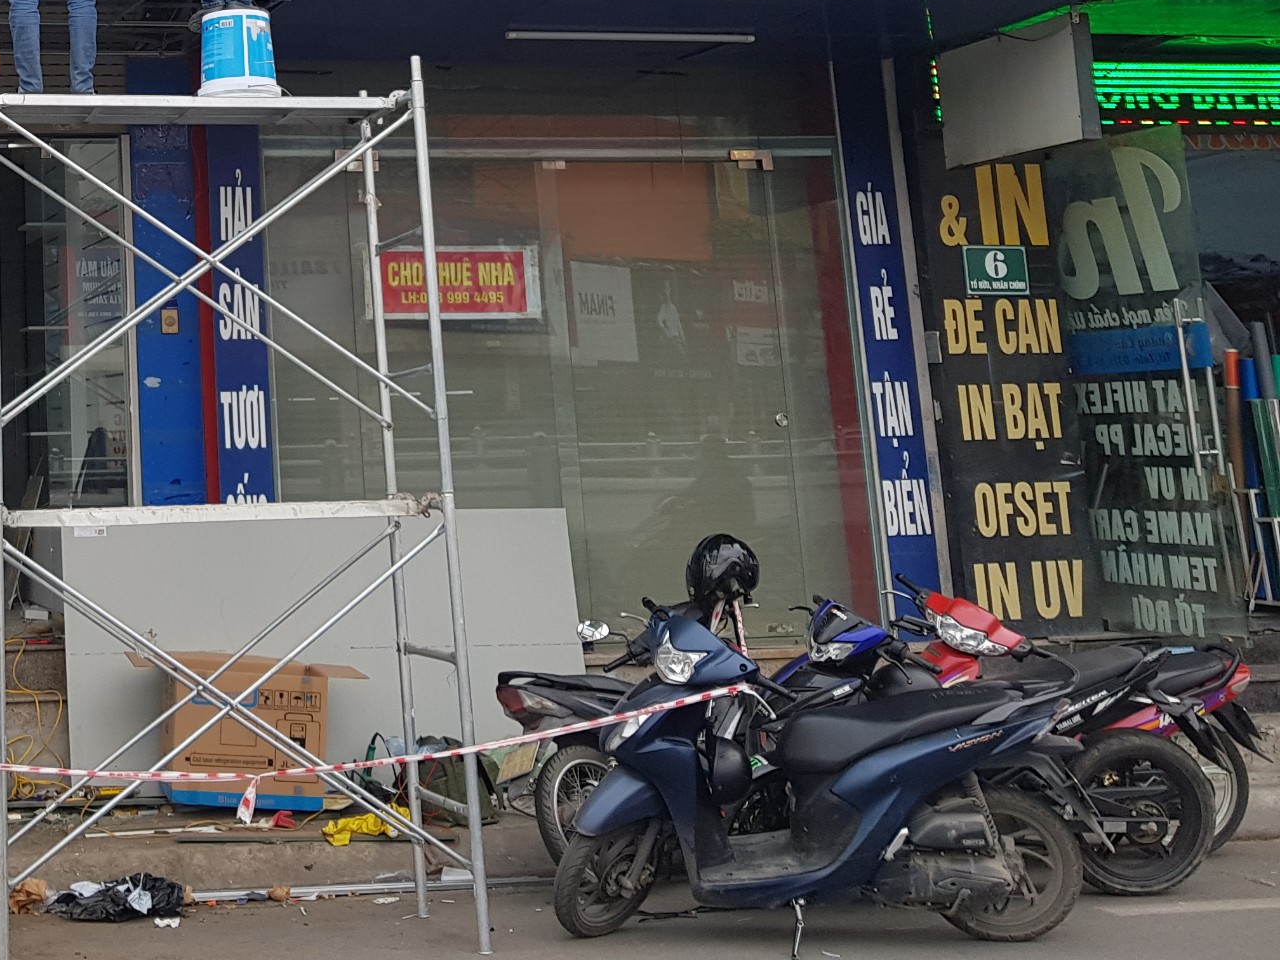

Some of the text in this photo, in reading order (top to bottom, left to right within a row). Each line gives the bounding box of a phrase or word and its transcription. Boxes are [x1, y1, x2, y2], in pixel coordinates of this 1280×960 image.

[220, 169, 253, 241] HẢI
[856, 181, 891, 246] GÍA
[939, 163, 1050, 247] & IN
[388, 257, 515, 287] CHO HUÊ NHÀ
[984, 250, 1008, 279] 6
[219, 268, 260, 340] SẢN
[447, 292, 504, 304] 999 4495
[869, 268, 899, 341] RẺ
[995, 298, 1063, 355] CAN
[221, 385, 267, 450] TƯƠI
[872, 379, 913, 448] TẬN
[957, 382, 1062, 451] IN BẠT
[882, 452, 933, 538] BIỂN
[975, 481, 1072, 538] OFSET
[974, 559, 1083, 621] IN UV
